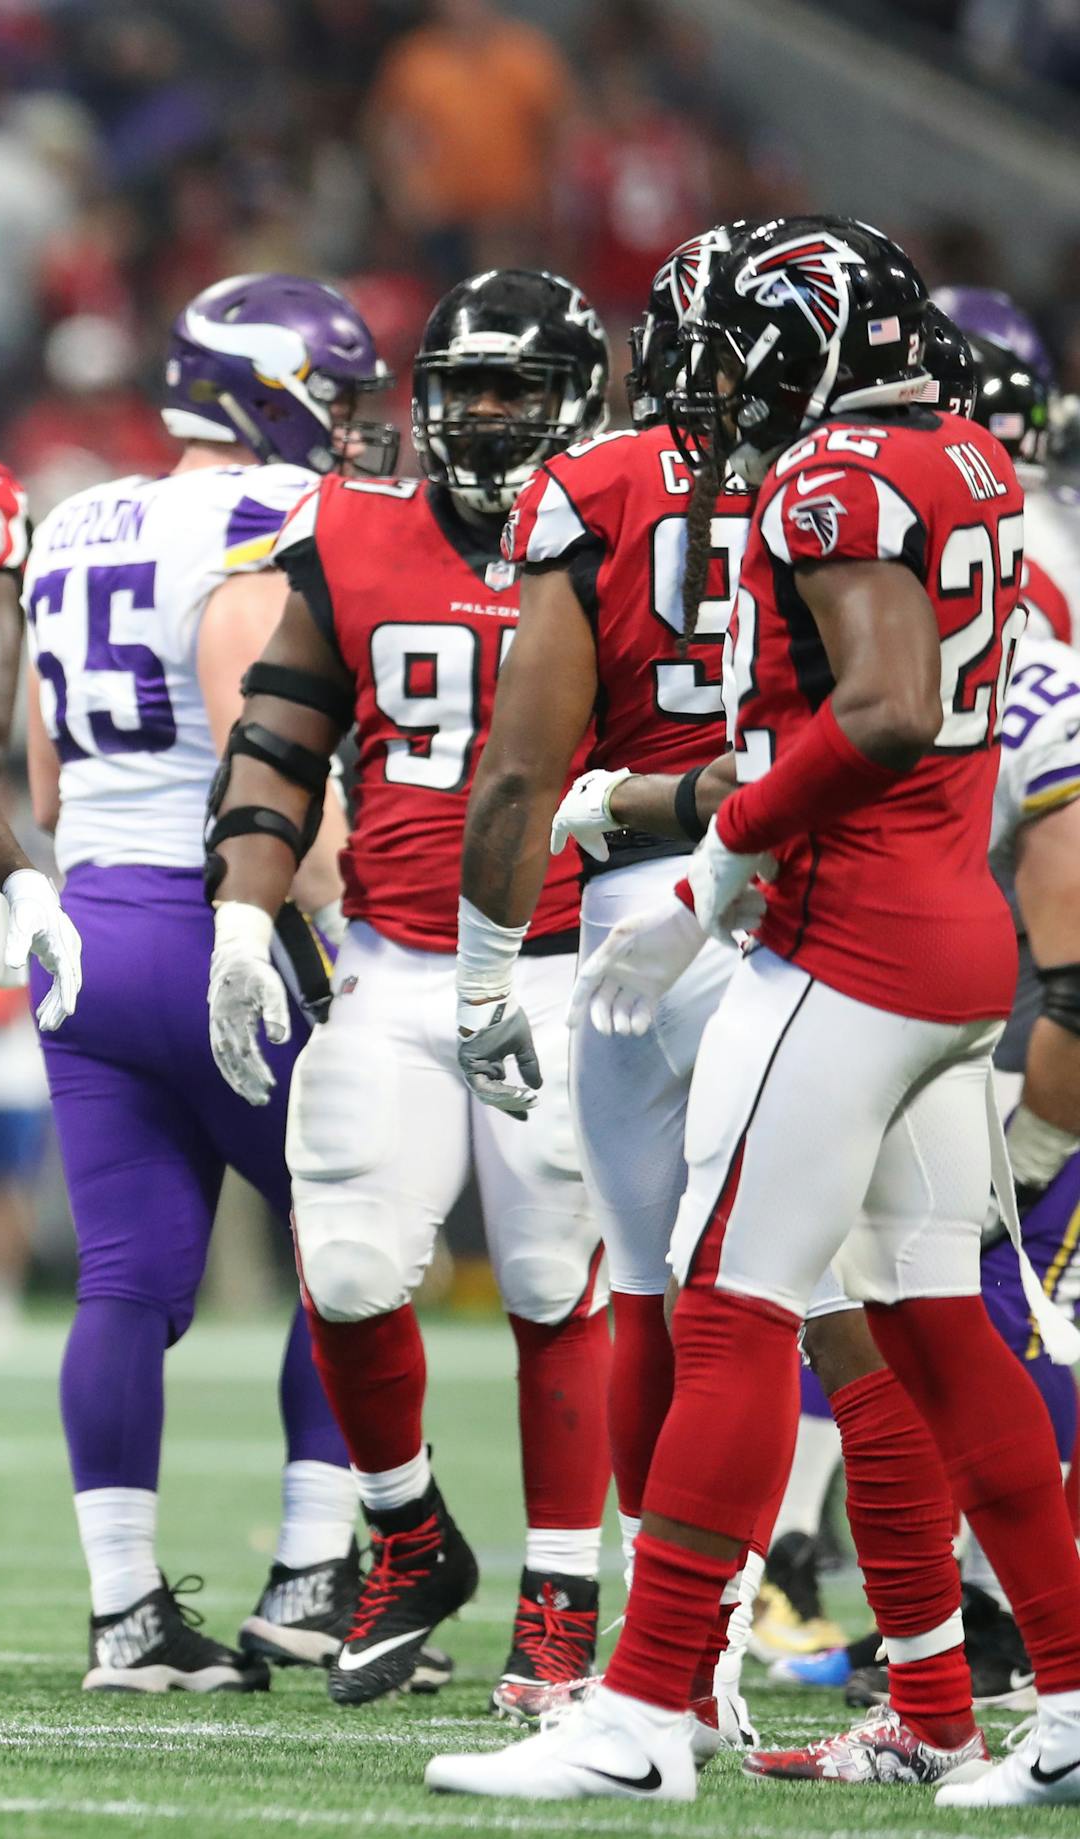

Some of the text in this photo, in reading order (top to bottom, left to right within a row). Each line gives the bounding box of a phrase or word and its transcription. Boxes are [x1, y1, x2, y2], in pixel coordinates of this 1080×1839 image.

[907, 333, 920, 366] 2
[450, 601, 520, 618] FALCON
[933, 512, 1029, 749] 22
[370, 622, 520, 791] 9
